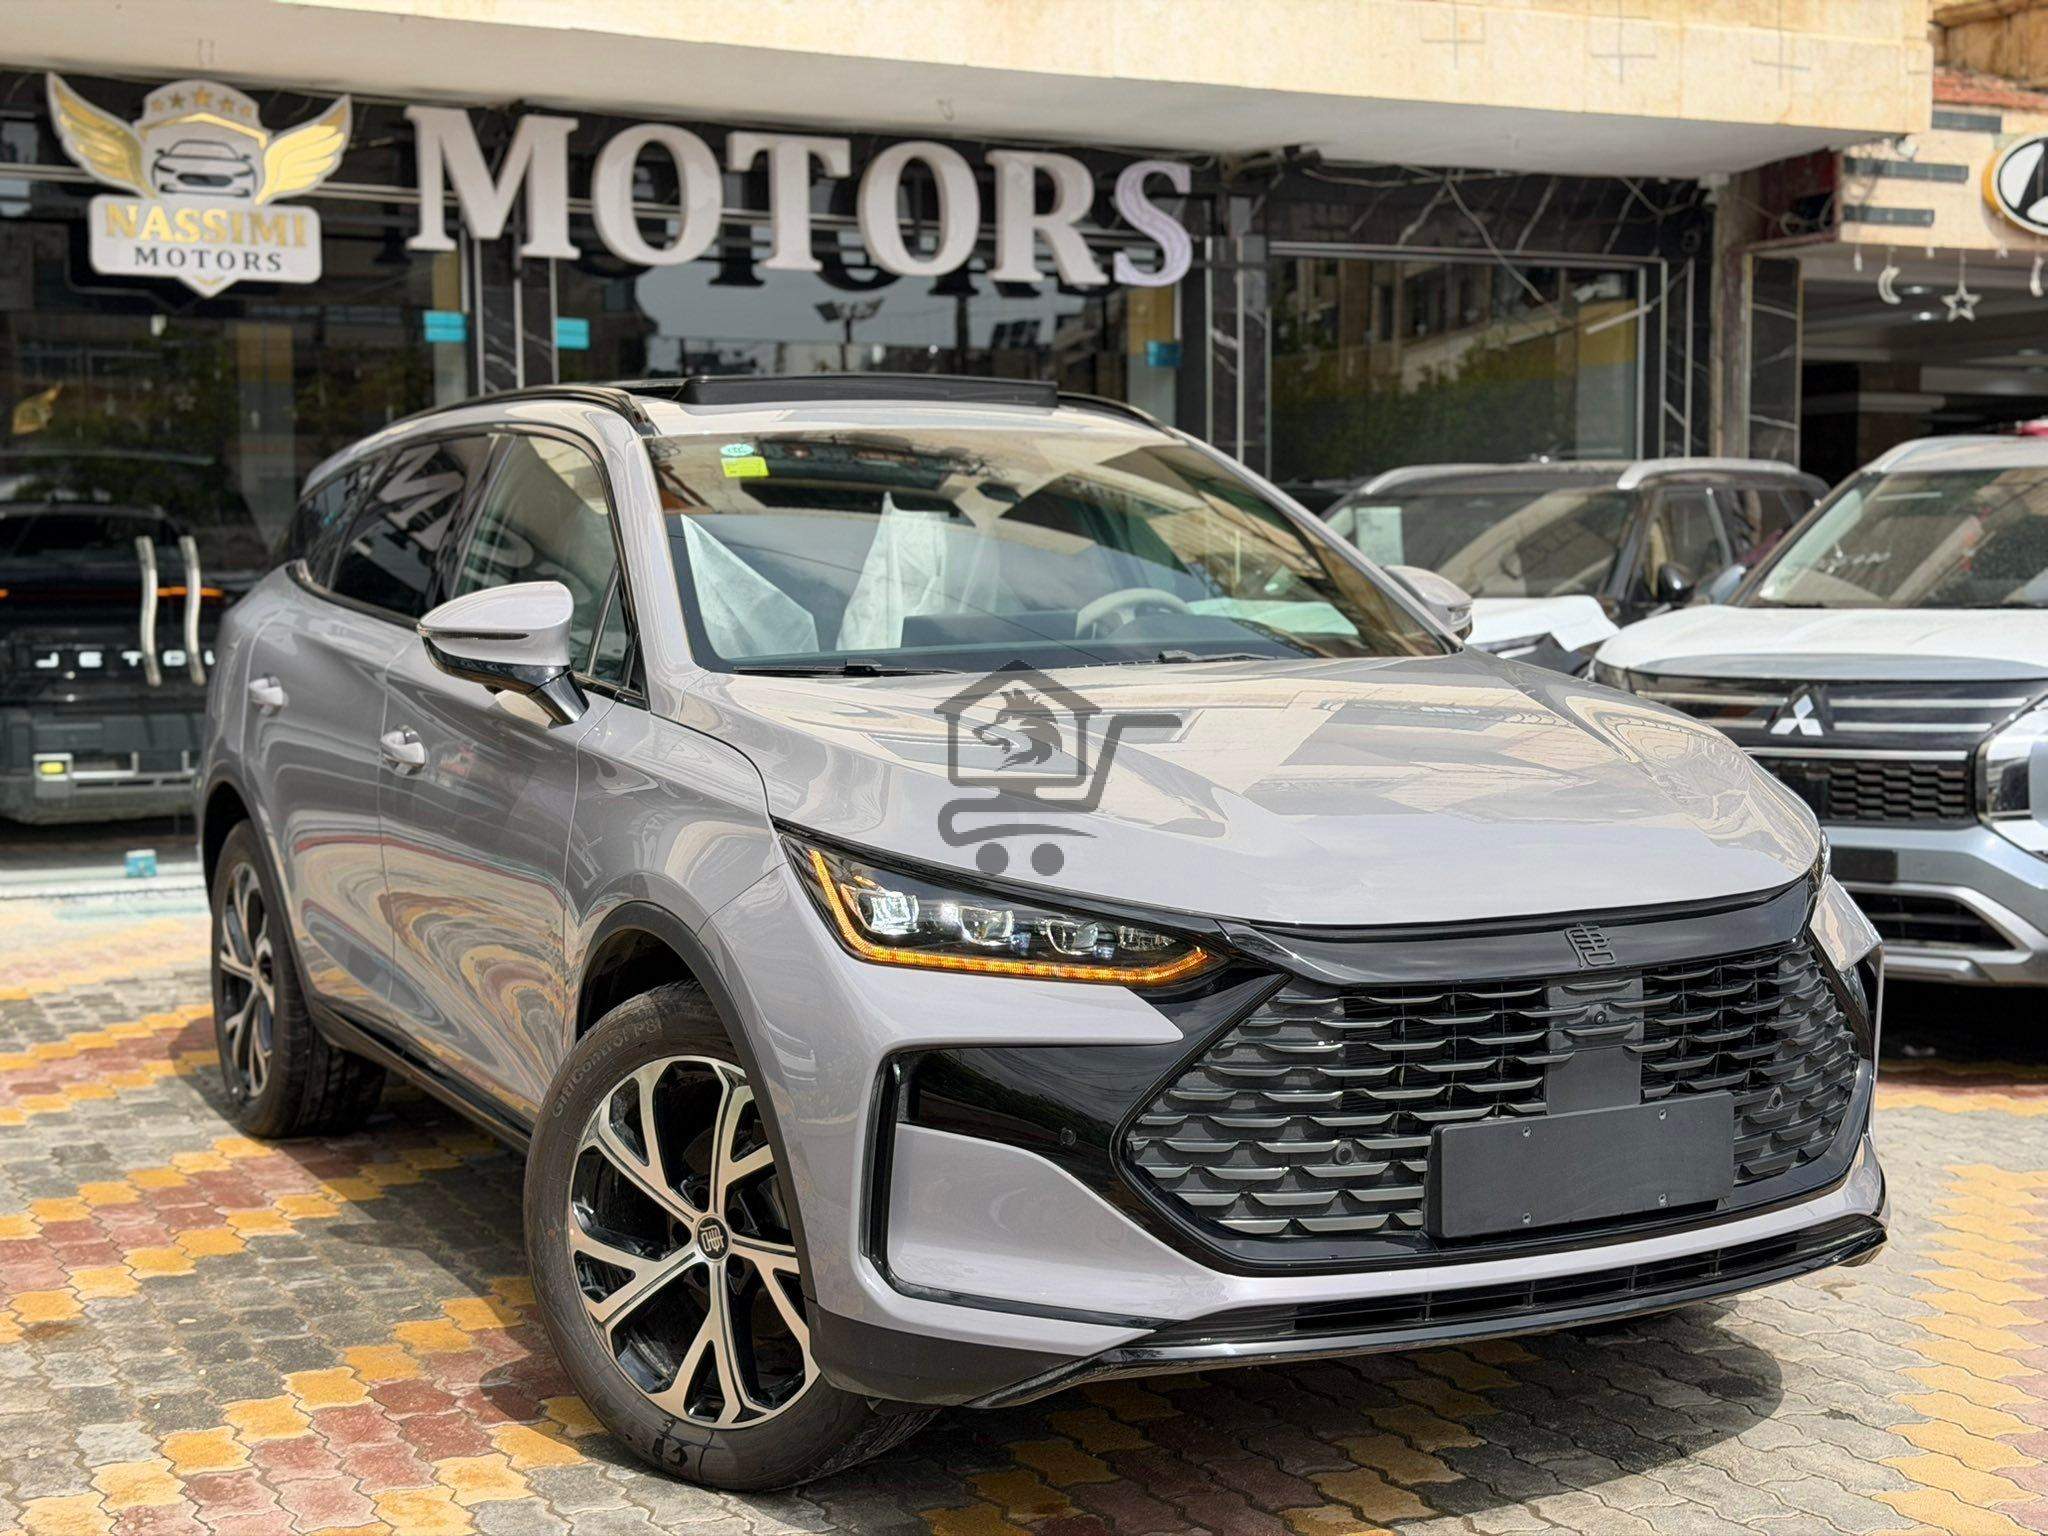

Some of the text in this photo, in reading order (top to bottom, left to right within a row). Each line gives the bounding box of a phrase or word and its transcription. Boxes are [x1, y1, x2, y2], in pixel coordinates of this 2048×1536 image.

[404, 105, 1194, 288] MOTORS
[105, 203, 307, 248] NASSIMI
[134, 246, 282, 272] MOTORS
